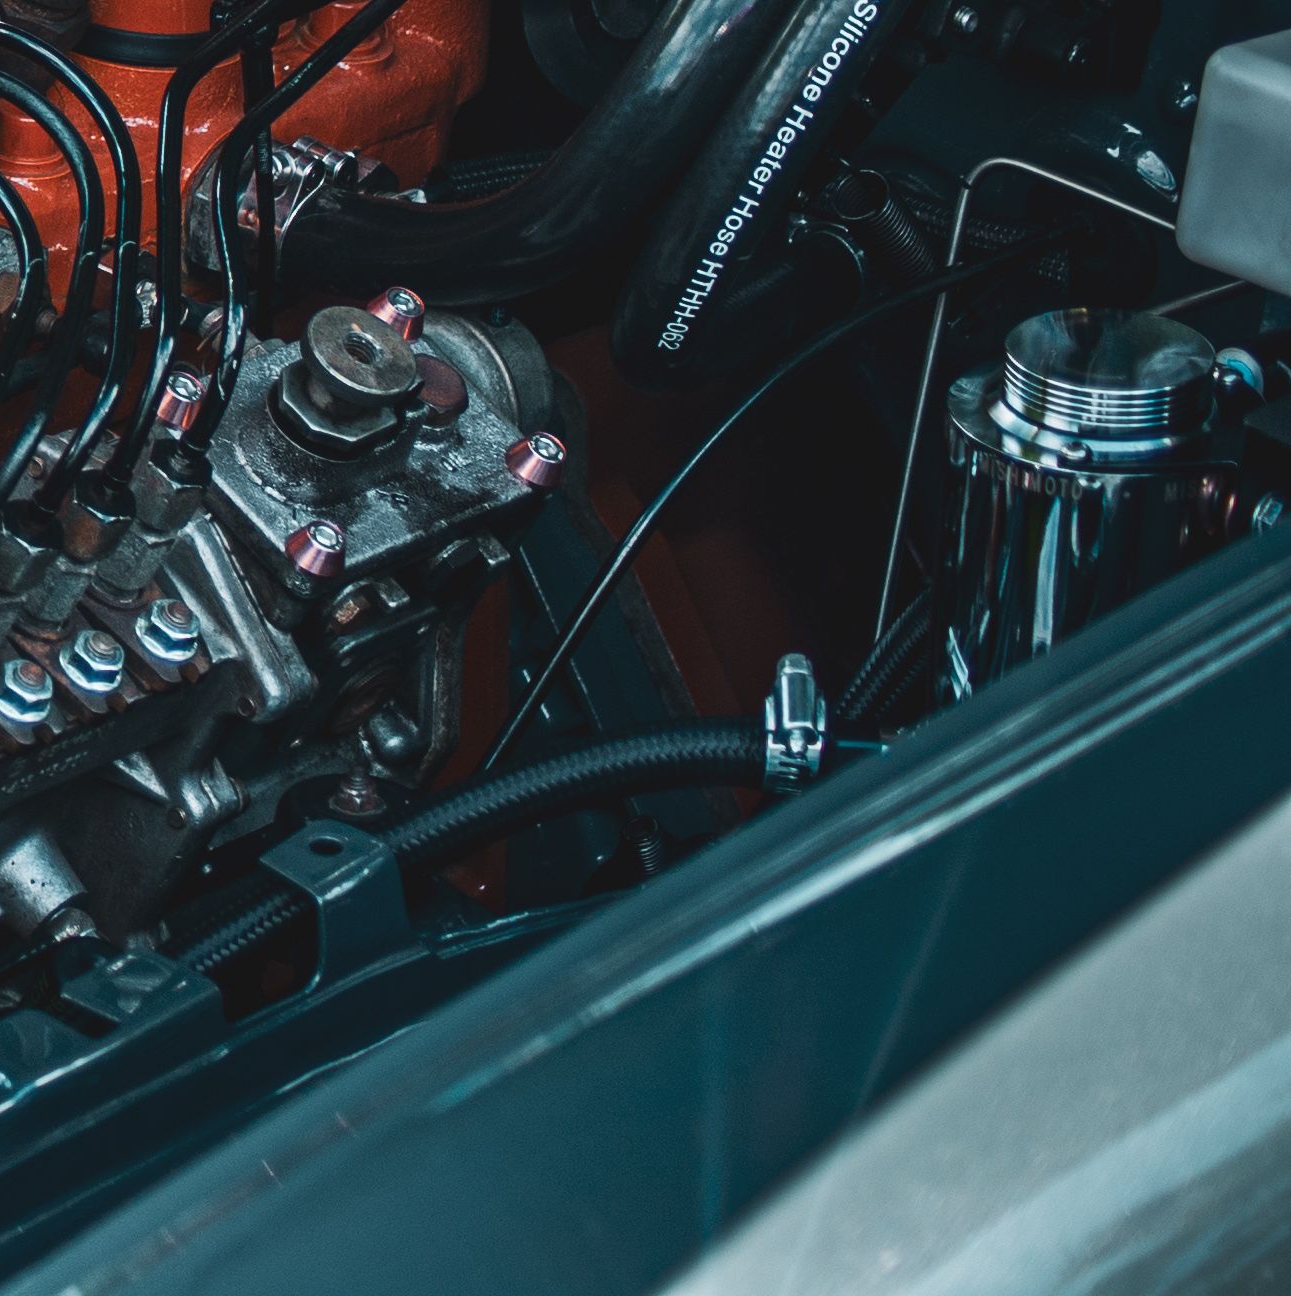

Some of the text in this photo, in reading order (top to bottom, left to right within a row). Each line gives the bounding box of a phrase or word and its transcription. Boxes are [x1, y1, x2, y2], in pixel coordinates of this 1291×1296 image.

[748, 104, 814, 195] Heater
[709, 195, 760, 256] Hose
[657, 259, 723, 352] HTHH-062
